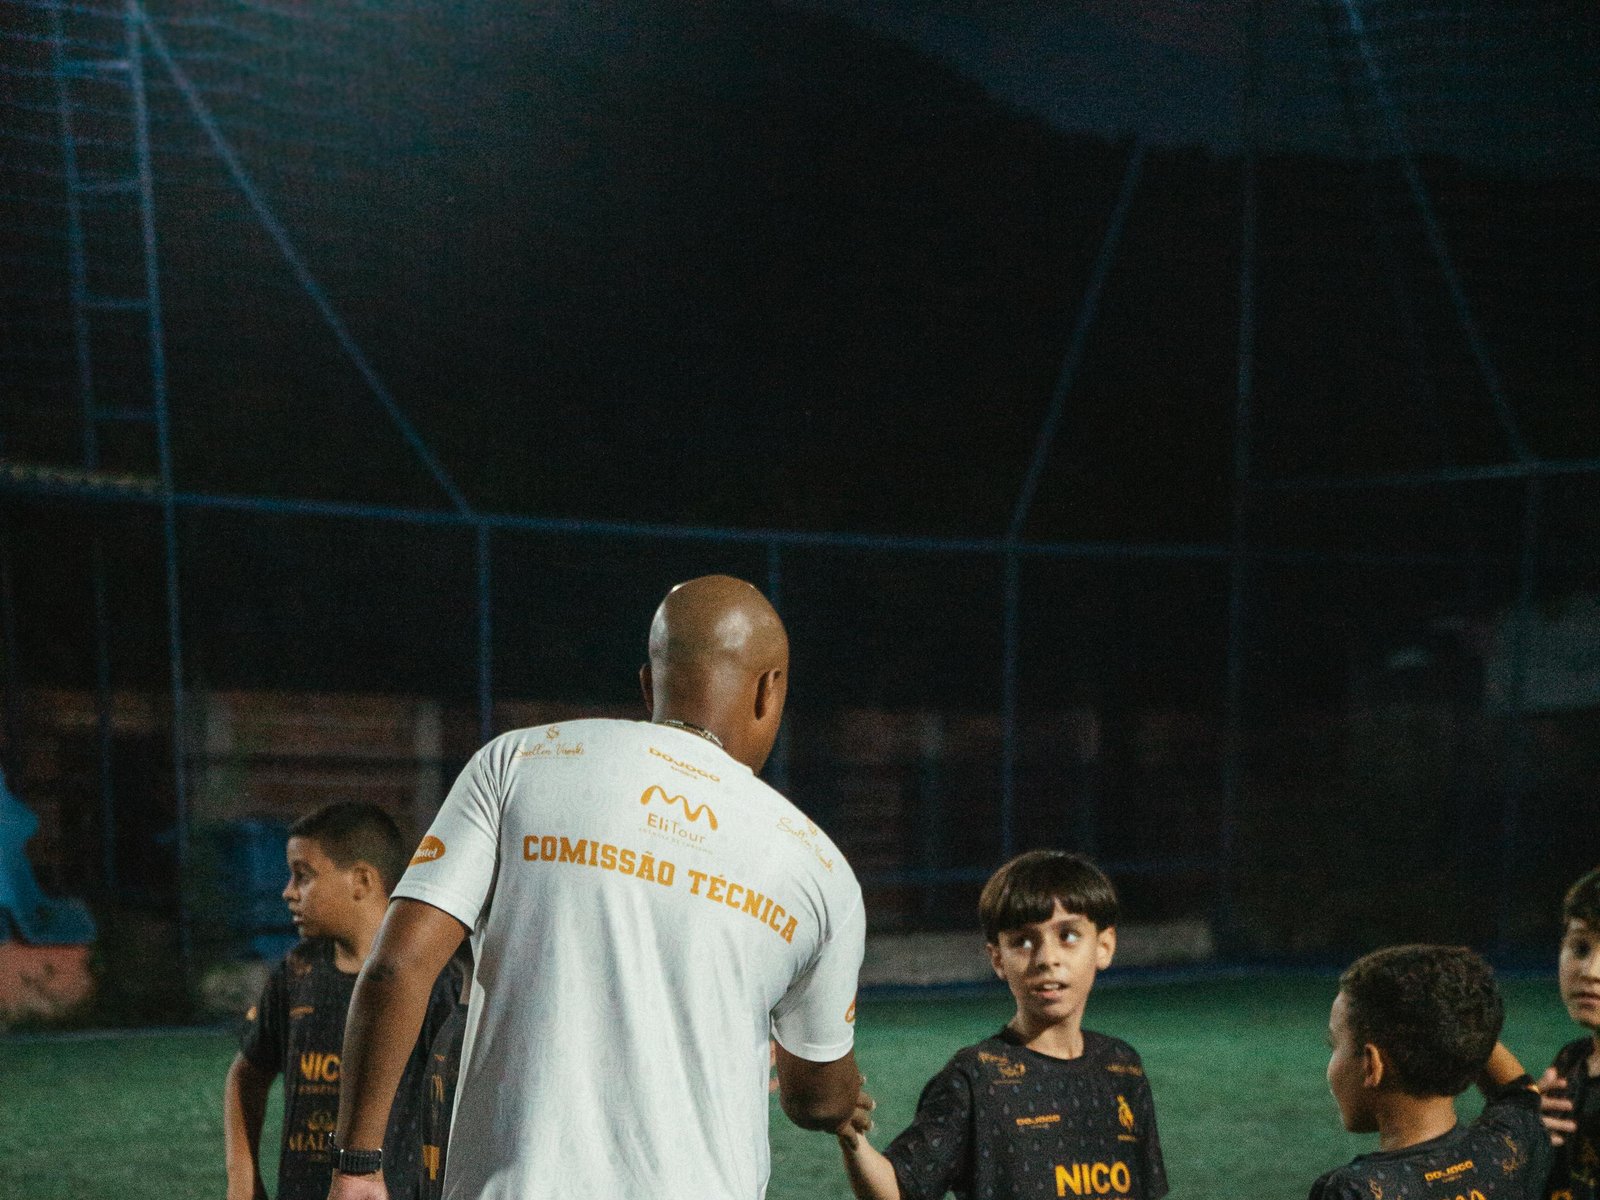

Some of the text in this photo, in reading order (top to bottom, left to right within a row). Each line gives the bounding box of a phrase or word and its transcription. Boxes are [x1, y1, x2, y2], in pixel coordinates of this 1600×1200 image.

[646, 812, 706, 843] EliTour
[523, 834, 676, 888] COMISSÃO
[688, 869, 799, 945] TÉCNICA
[301, 1052, 341, 1082] NIC
[1055, 1160, 1132, 1197] NICO
